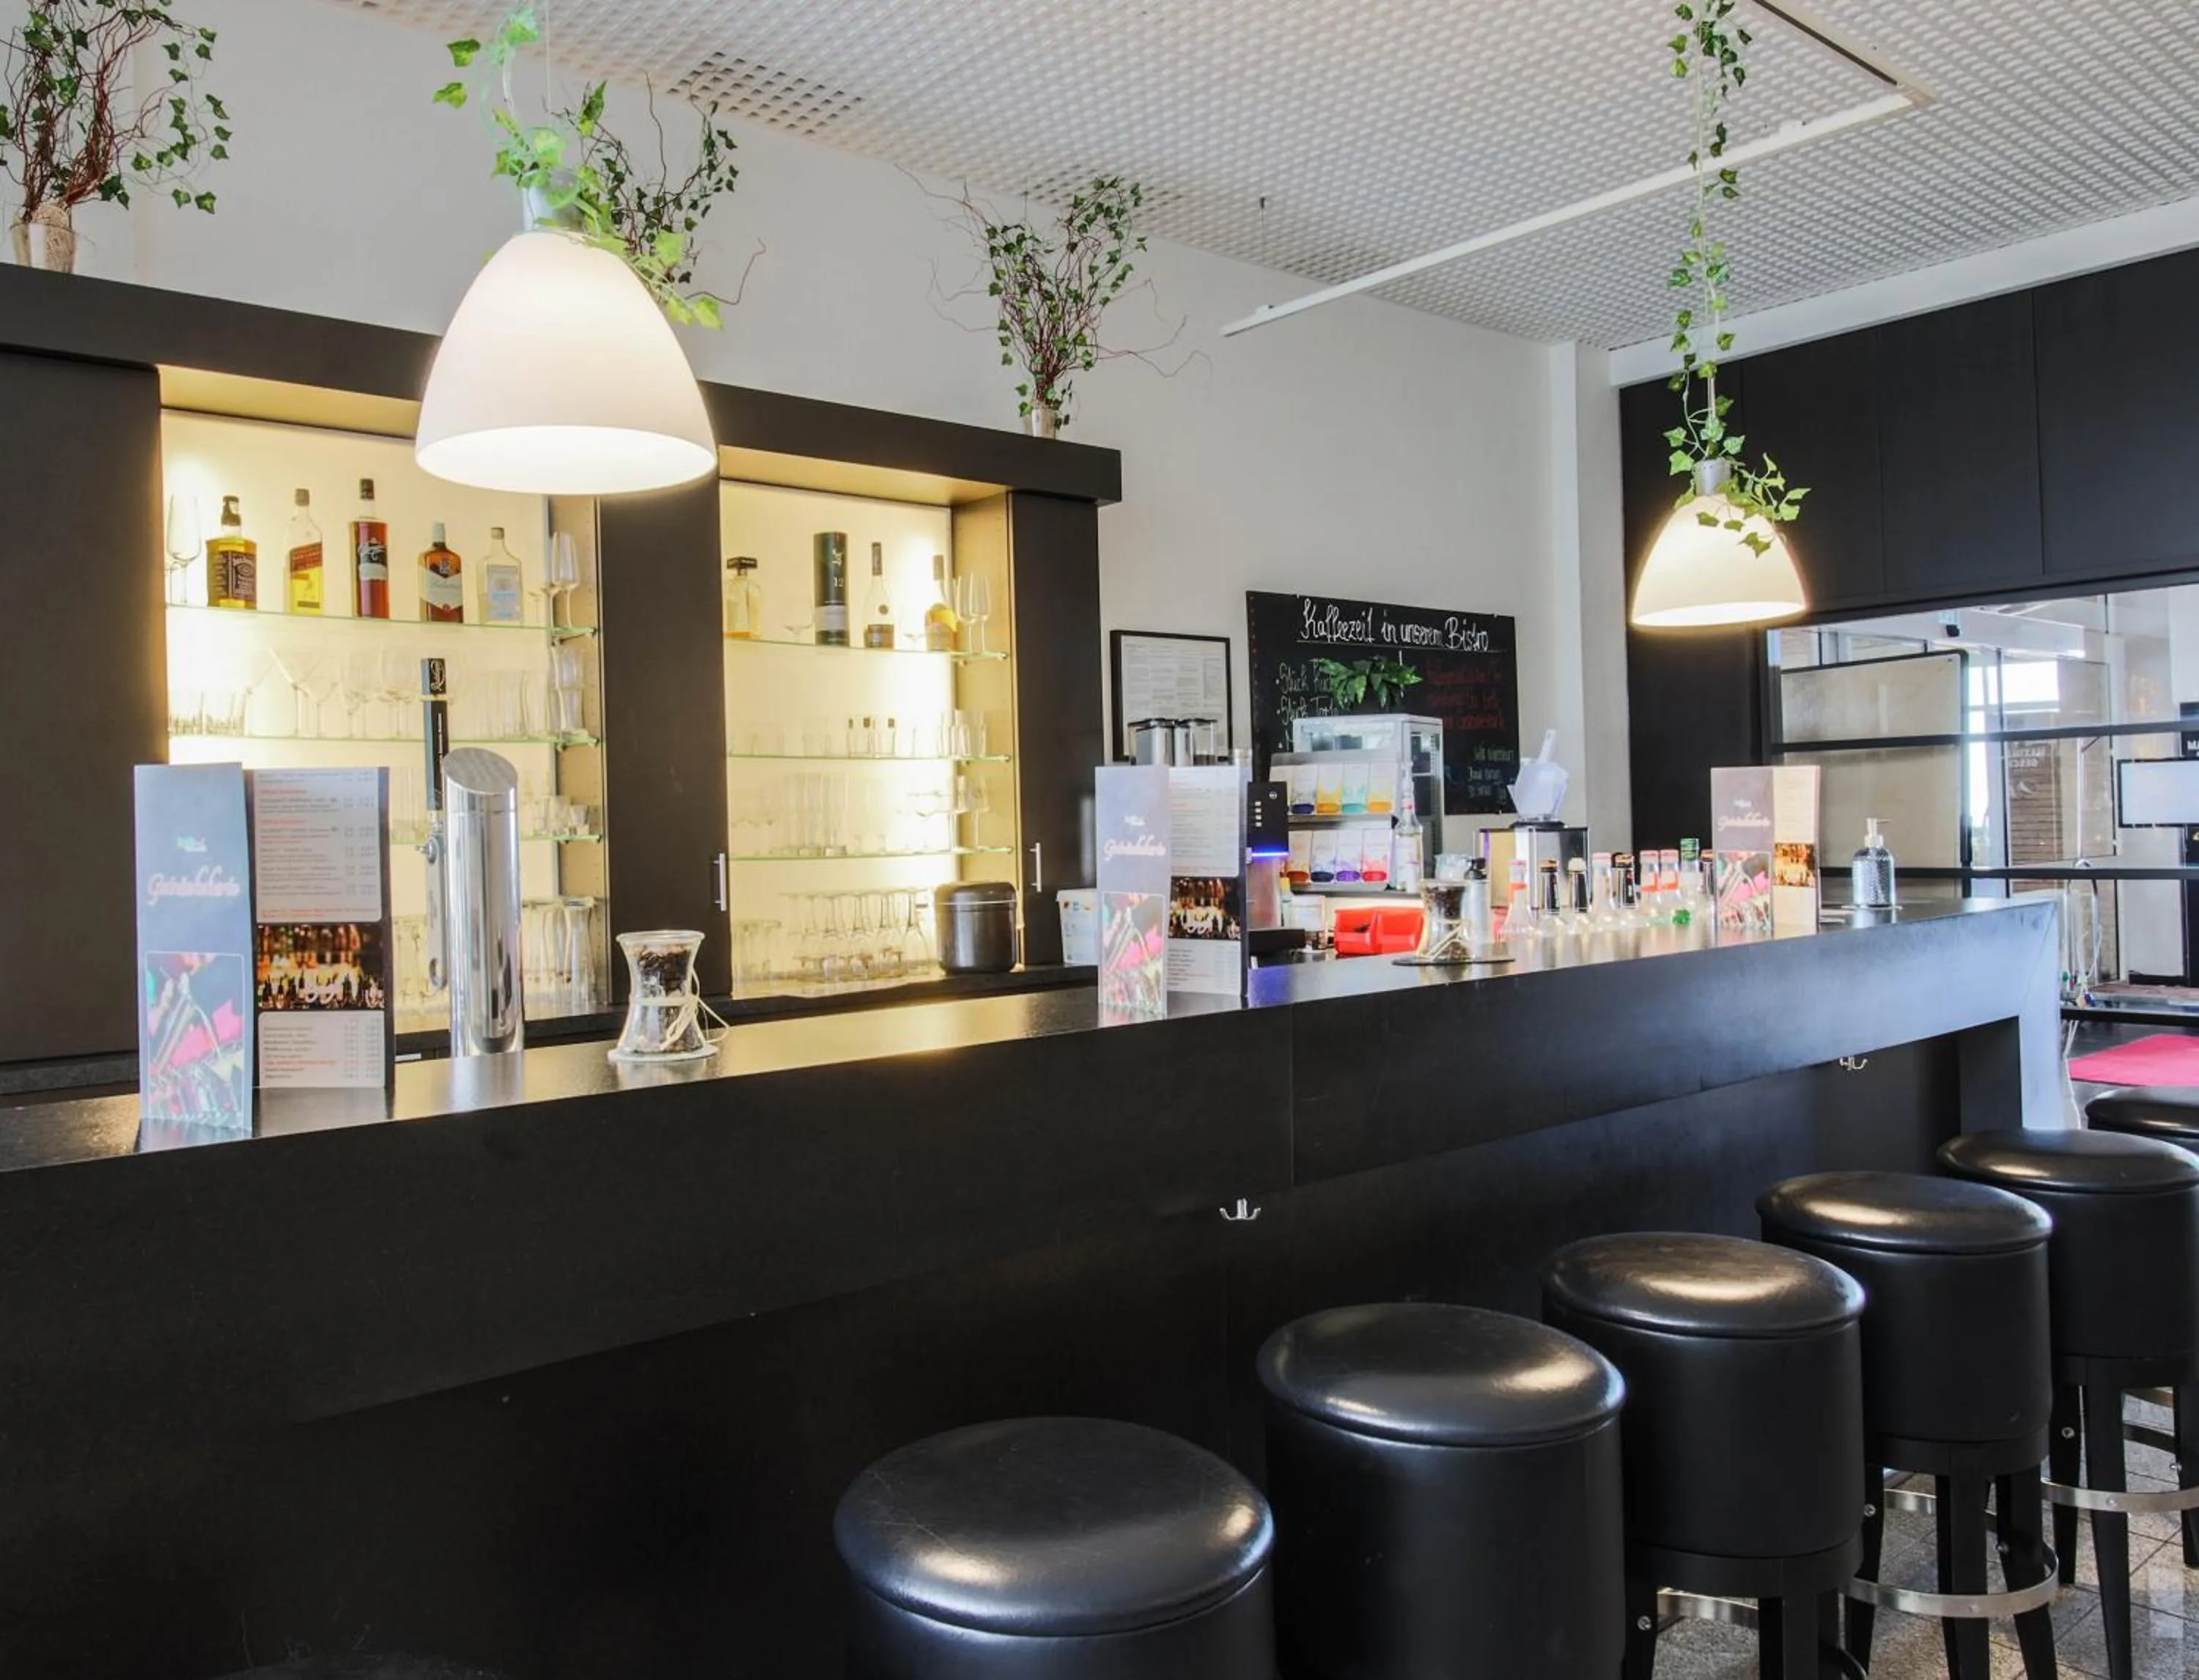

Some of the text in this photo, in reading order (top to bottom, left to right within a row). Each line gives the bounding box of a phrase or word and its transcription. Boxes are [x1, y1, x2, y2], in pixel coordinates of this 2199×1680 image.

[1300, 597, 1375, 644] Kaffeezeit
[1381, 609, 1398, 644] in
[1445, 616, 1489, 652] Bistro
